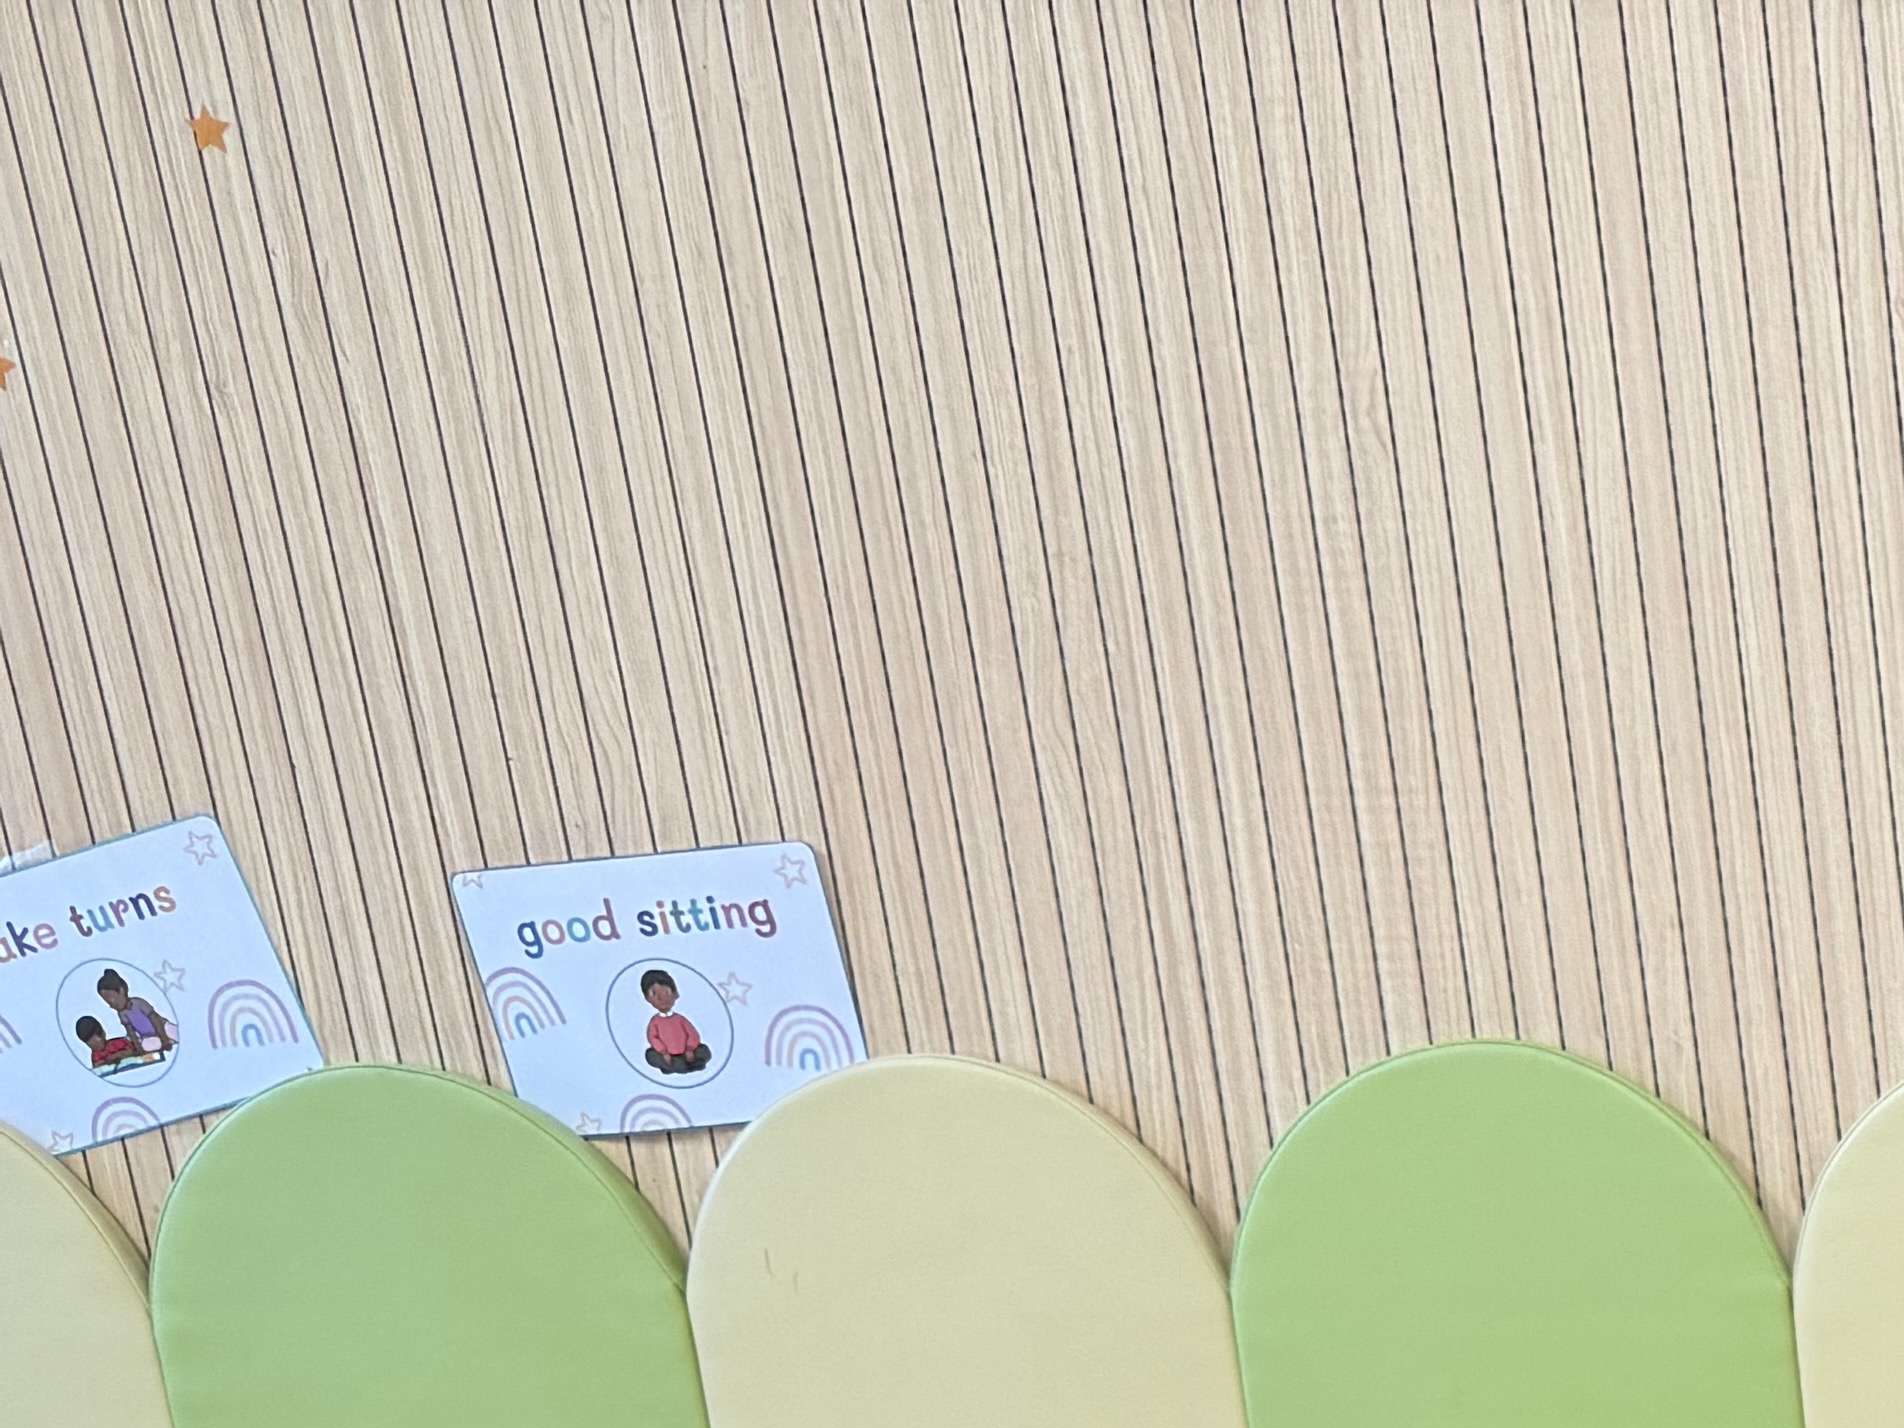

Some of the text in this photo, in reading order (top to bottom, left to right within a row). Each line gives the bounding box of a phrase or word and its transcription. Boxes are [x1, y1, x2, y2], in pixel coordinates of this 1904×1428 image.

[69, 885, 177, 938] turns
[516, 895, 777, 960] good sitting
